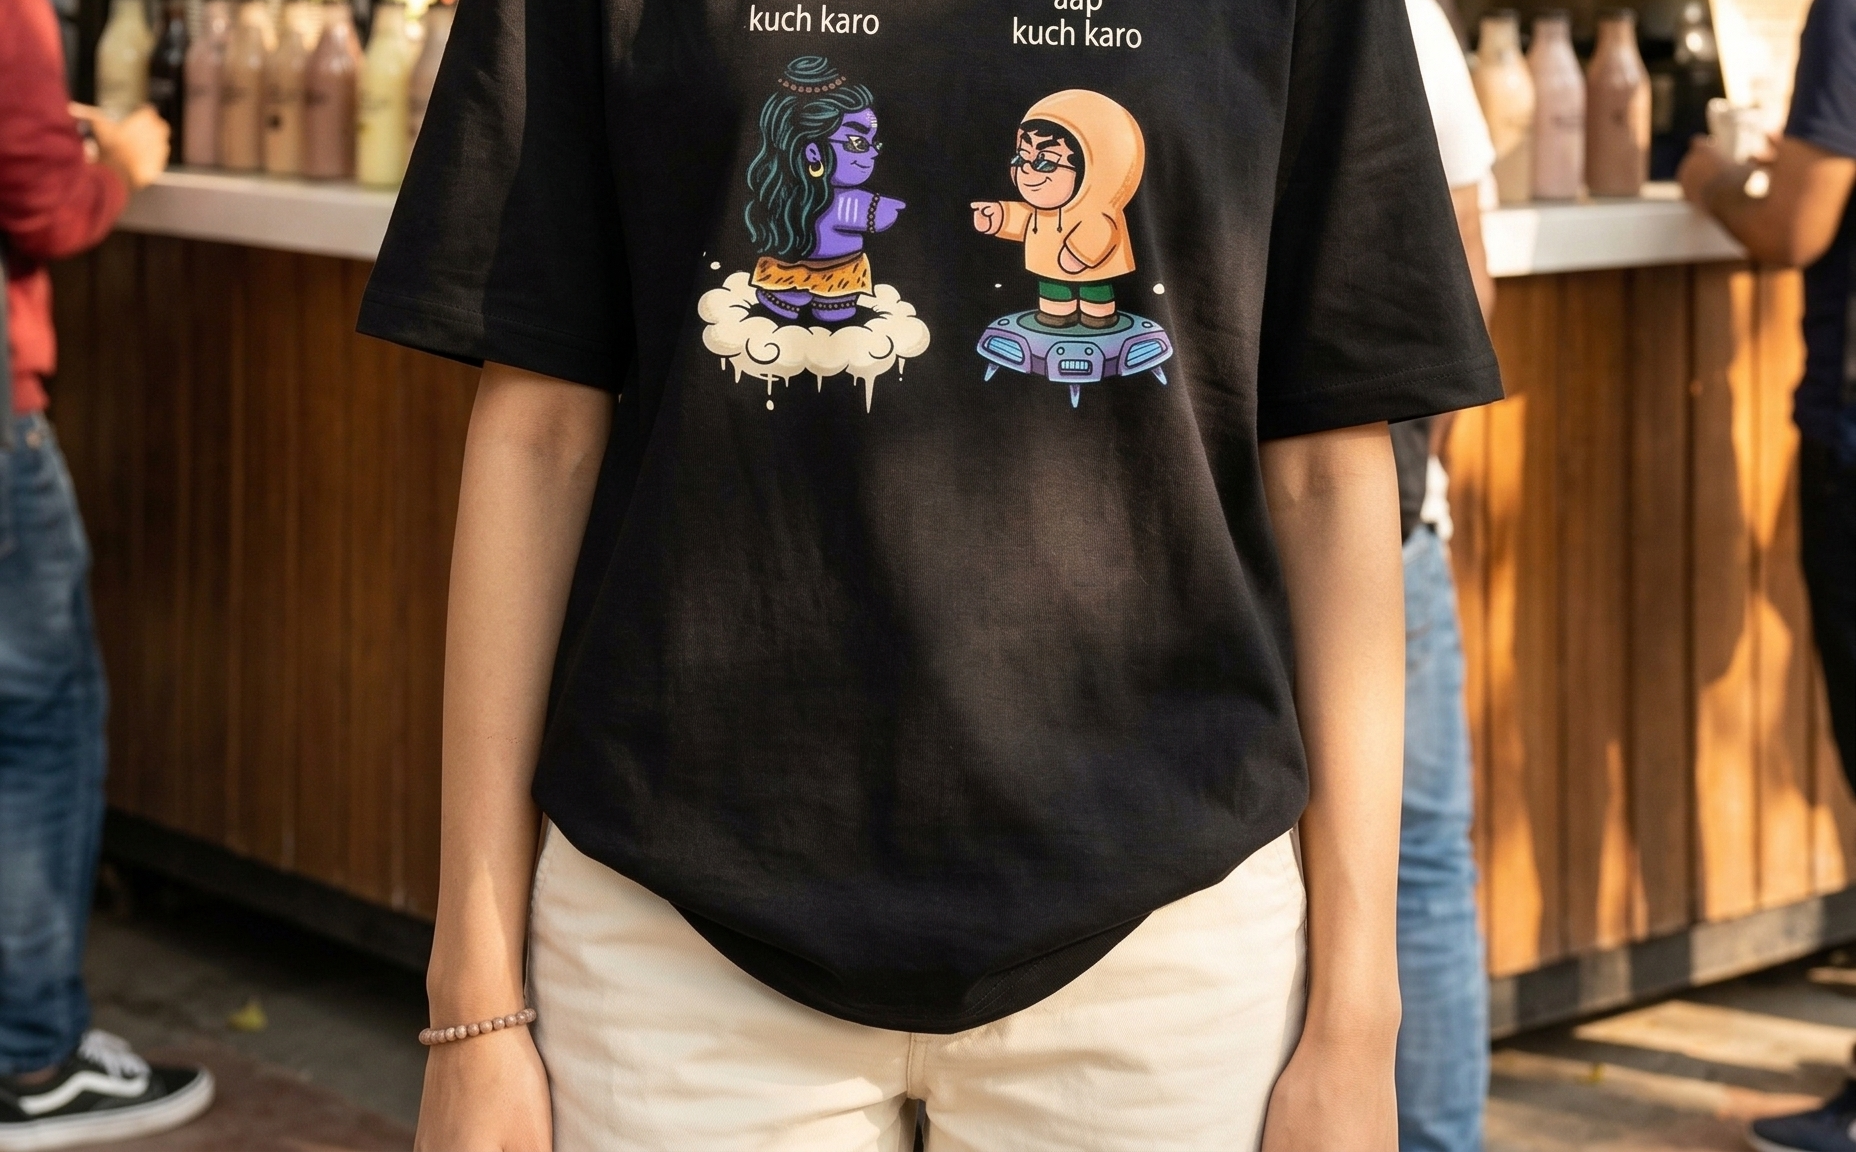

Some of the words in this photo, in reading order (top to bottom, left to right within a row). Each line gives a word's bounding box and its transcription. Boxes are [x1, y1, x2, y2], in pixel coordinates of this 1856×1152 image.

[749, 4, 812, 33] kuch
[821, 4, 880, 35] karo
[1013, 16, 1076, 47] kuch
[1085, 18, 1142, 49] karo
